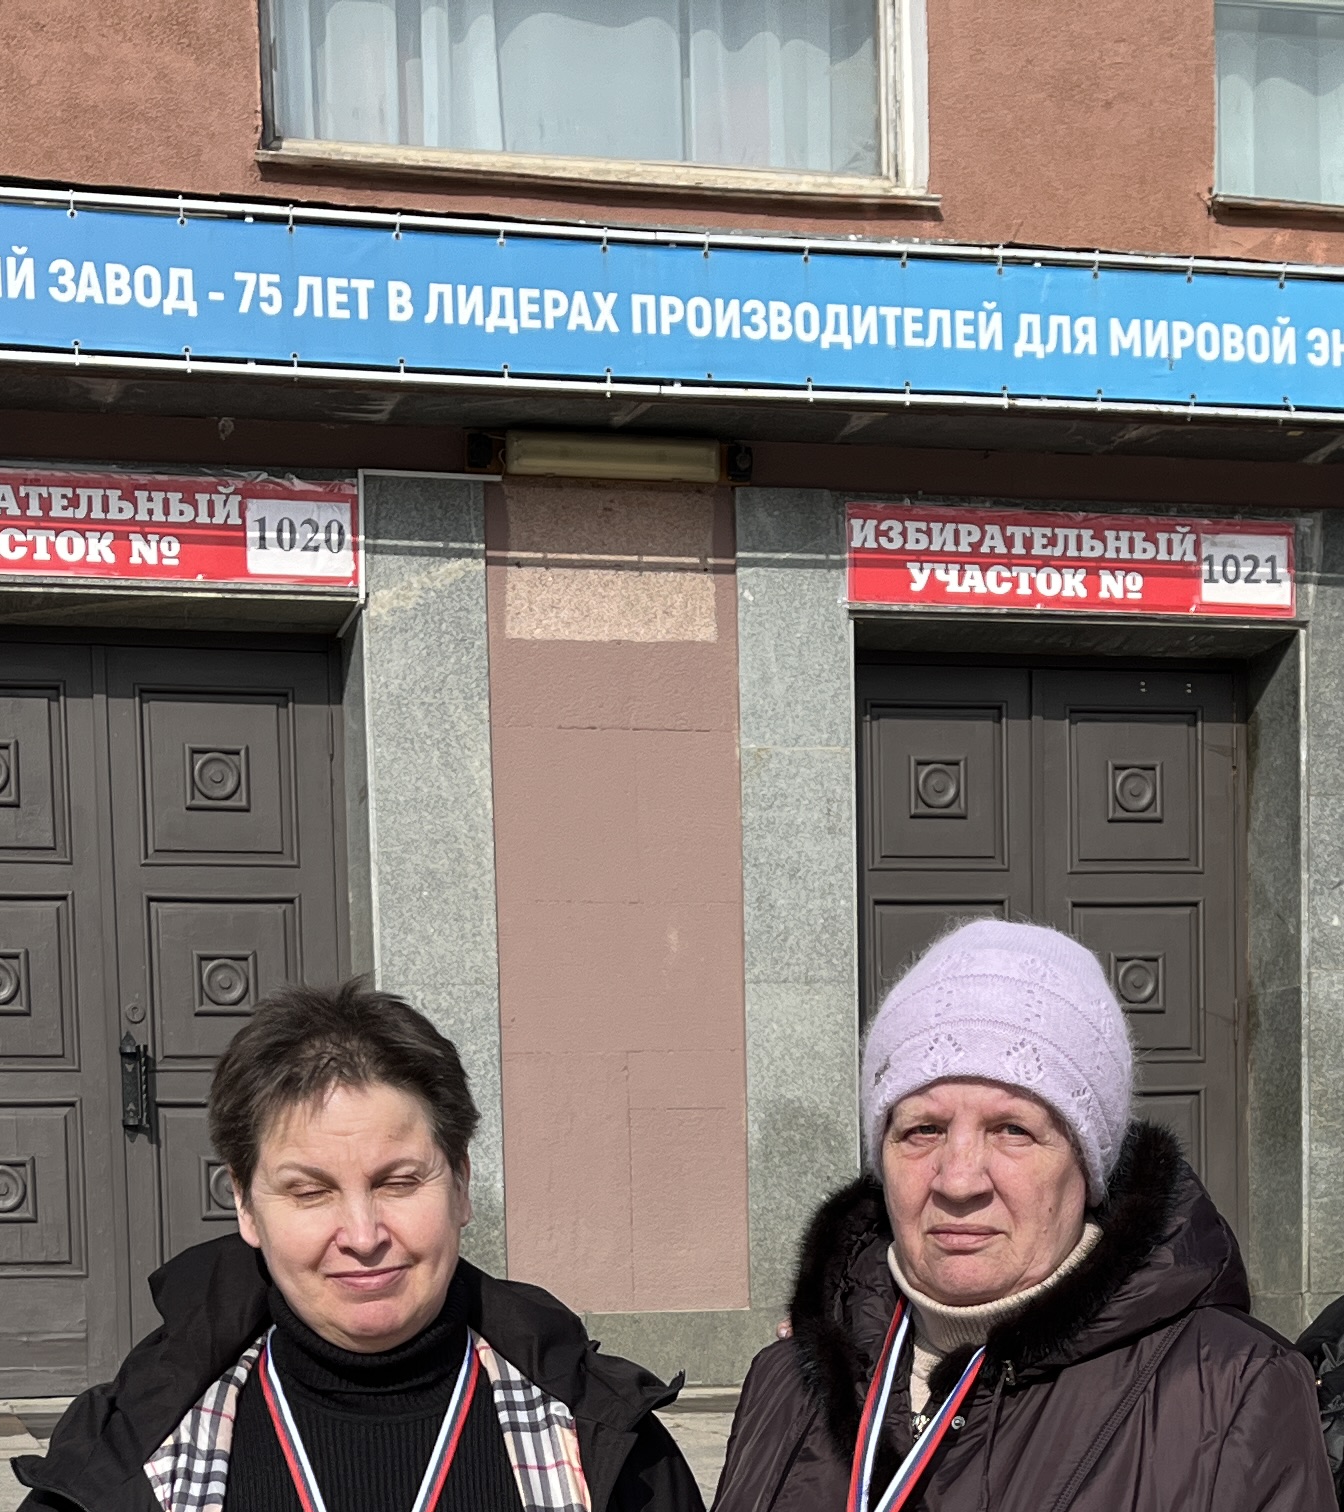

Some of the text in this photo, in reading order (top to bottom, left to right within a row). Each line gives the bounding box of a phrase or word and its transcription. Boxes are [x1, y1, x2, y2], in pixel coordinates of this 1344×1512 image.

[48, 259, 198, 317] ЗАВОД
[234, 271, 283, 315] 75
[293, 275, 375, 320] ЛЕТ
[387, 280, 414, 322] В
[424, 283, 620, 334] ЛИДЕРАХ
[631, 293, 1003, 351] ПРОИЗВОДИТЕЛЕЙ
[1014, 313, 1097, 359] ДЛЯ
[1110, 317, 1297, 365] МИРОВОЙ
[128, 532, 181, 568] №
[253, 515, 346, 554] 1020
[849, 517, 1198, 563] ИЗБИРАТЕЛЬНЫЙ
[906, 553, 1283, 602] УЧАСТОК № 1021
